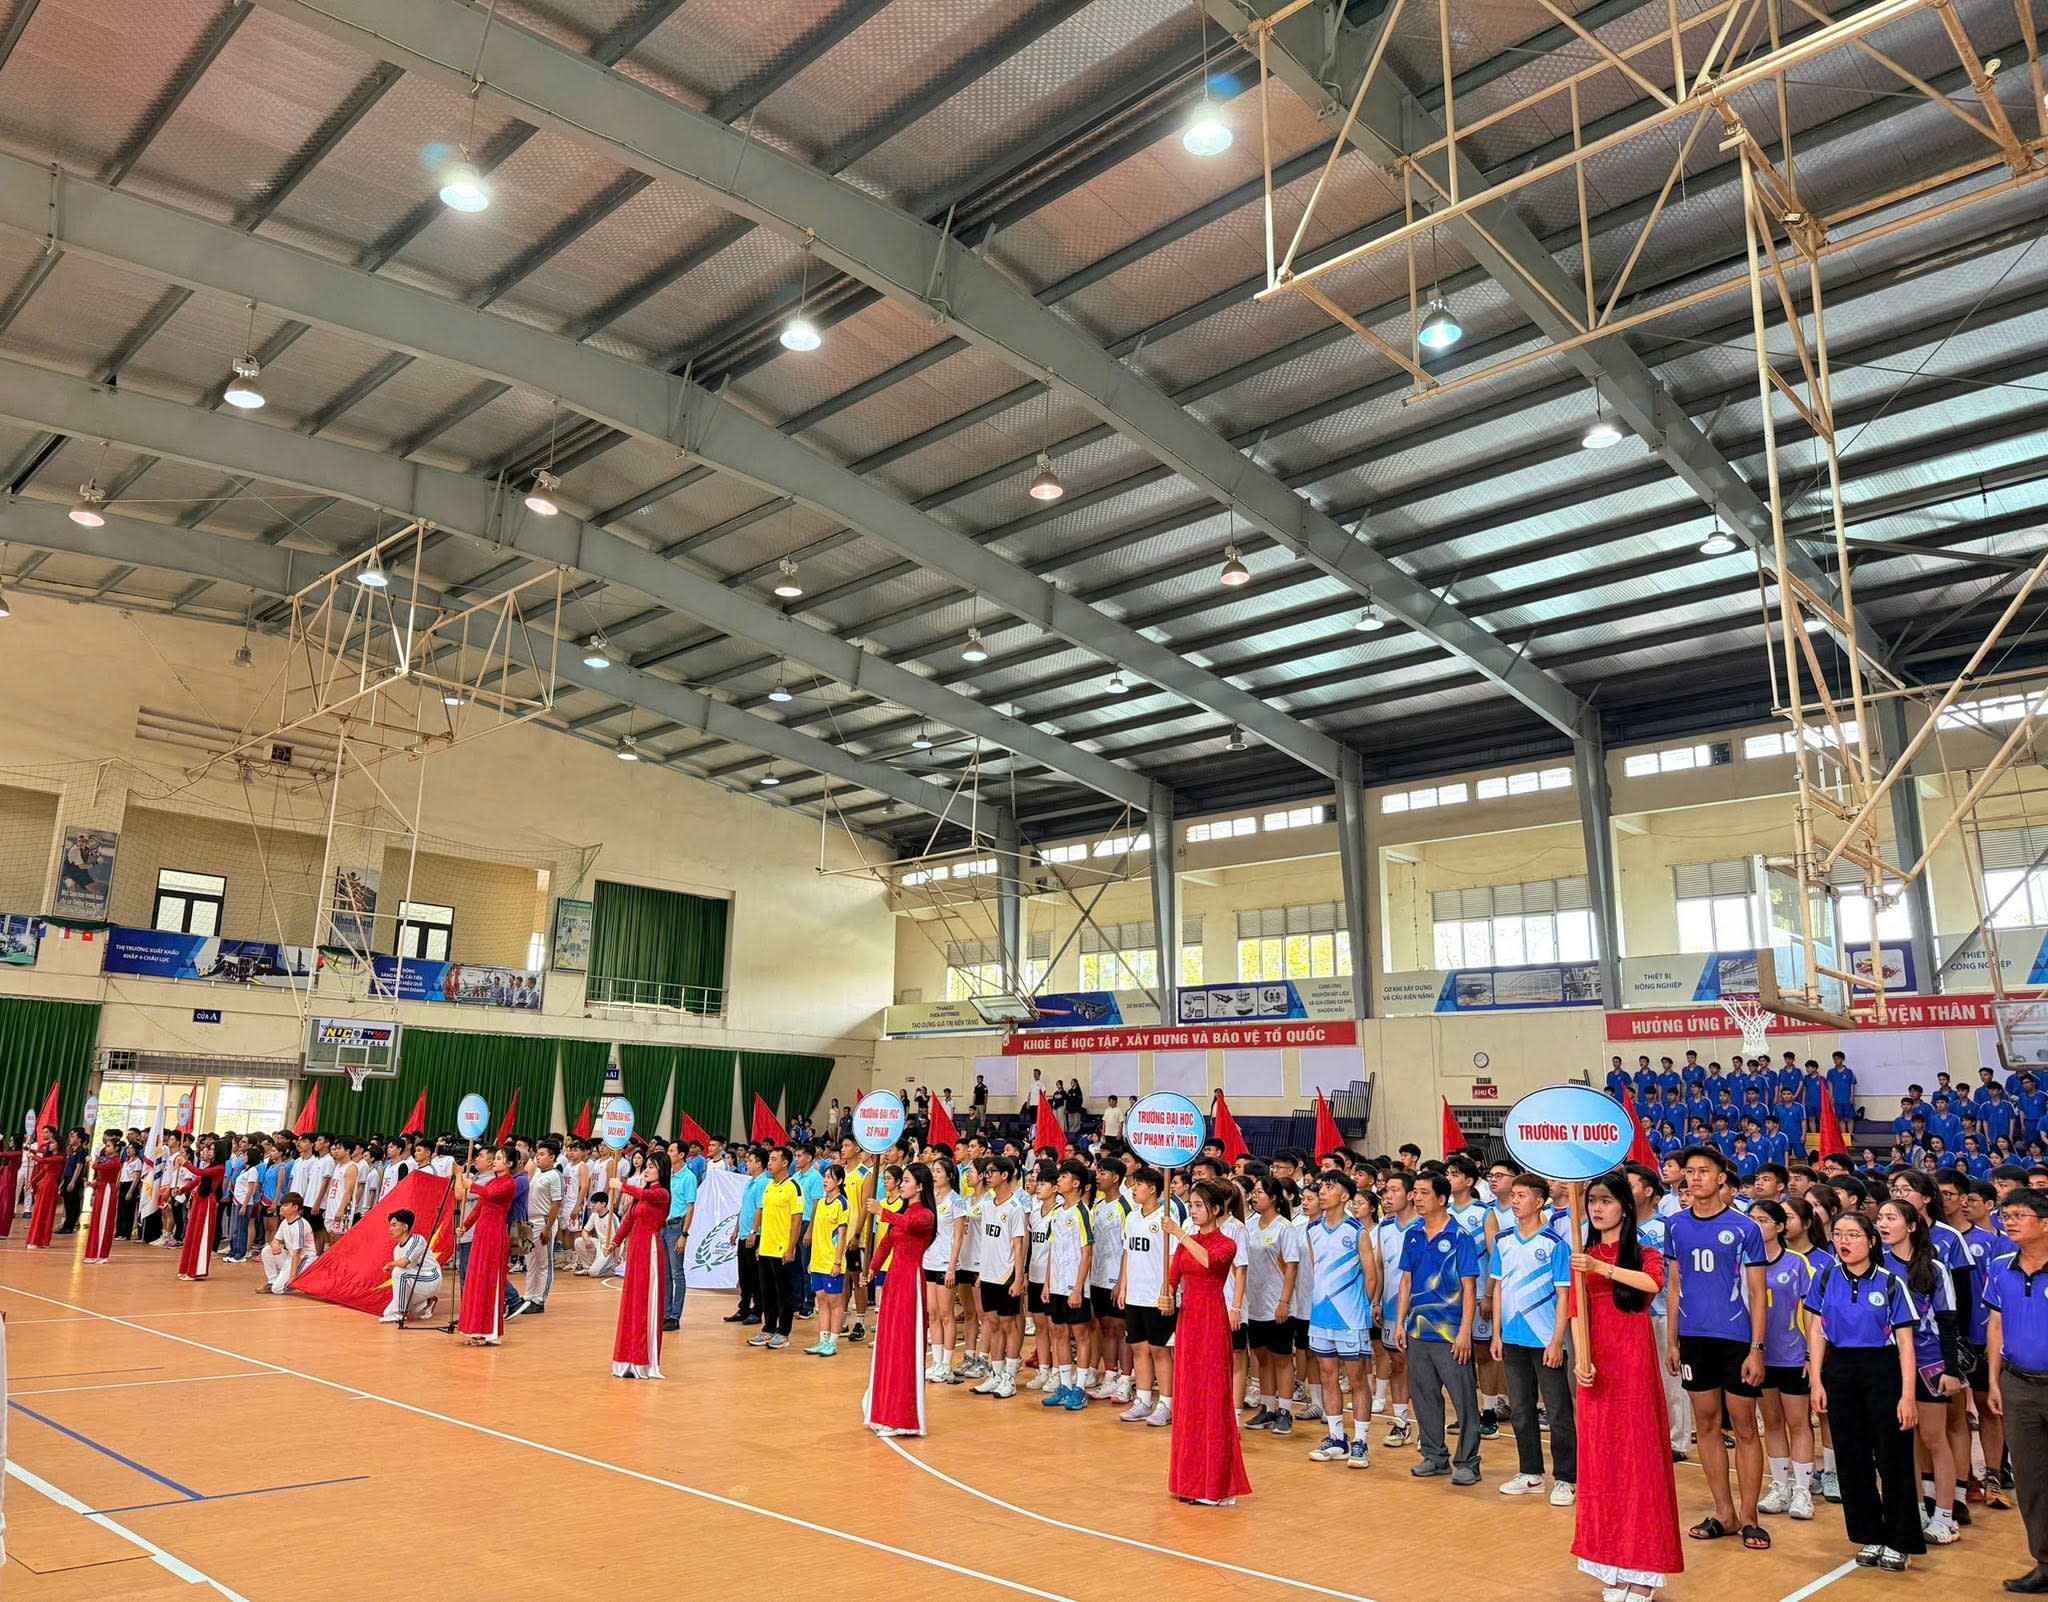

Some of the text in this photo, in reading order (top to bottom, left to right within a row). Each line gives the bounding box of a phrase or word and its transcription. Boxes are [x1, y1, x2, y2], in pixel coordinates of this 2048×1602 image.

[1951, 961, 1976, 970] CÔNG
[1644, 972, 1663, 980] THIẾT
[1634, 981, 1682, 990] NÔNG NGHIỆP
[210, 1012, 217, 1021] A
[1632, 1015, 1683, 1034] HƯỞNG
[1688, 1014, 1720, 1033] ỨNG
[1927, 1002, 1976, 1020] THÂN
[319, 1037, 386, 1047] BASKETBALL
[1072, 1037, 1095, 1051] HỌC
[1097, 1034, 1123, 1048] TẬP,
[1127, 1034, 1149, 1047] XÂY
[1153, 1033, 1188, 1047] DỰNG
[1192, 1029, 1209, 1044] VÀ
[1212, 1029, 1240, 1044] BẢO
[1243, 1028, 1261, 1046] VỆ
[1264, 1027, 1283, 1043] TỔ
[1286, 1025, 1326, 1042] QUỐC
[1138, 1108, 1194, 1128] TRƯỜNG ĐẠI HỌC
[1133, 1131, 1143, 1144] SƯ
[1144, 1132, 1164, 1149] PHẠM
[1177, 1133, 1197, 1151] THUẬT
[1518, 1121, 1618, 1145] TRƯỜNG Y DƯỢC
[986, 1223, 1001, 1237] UED
[1032, 1231, 1046, 1243] UED
[1129, 1236, 1150, 1252] UED
[1691, 1248, 1715, 1273] 10
[1681, 1363, 1693, 1381] 10
